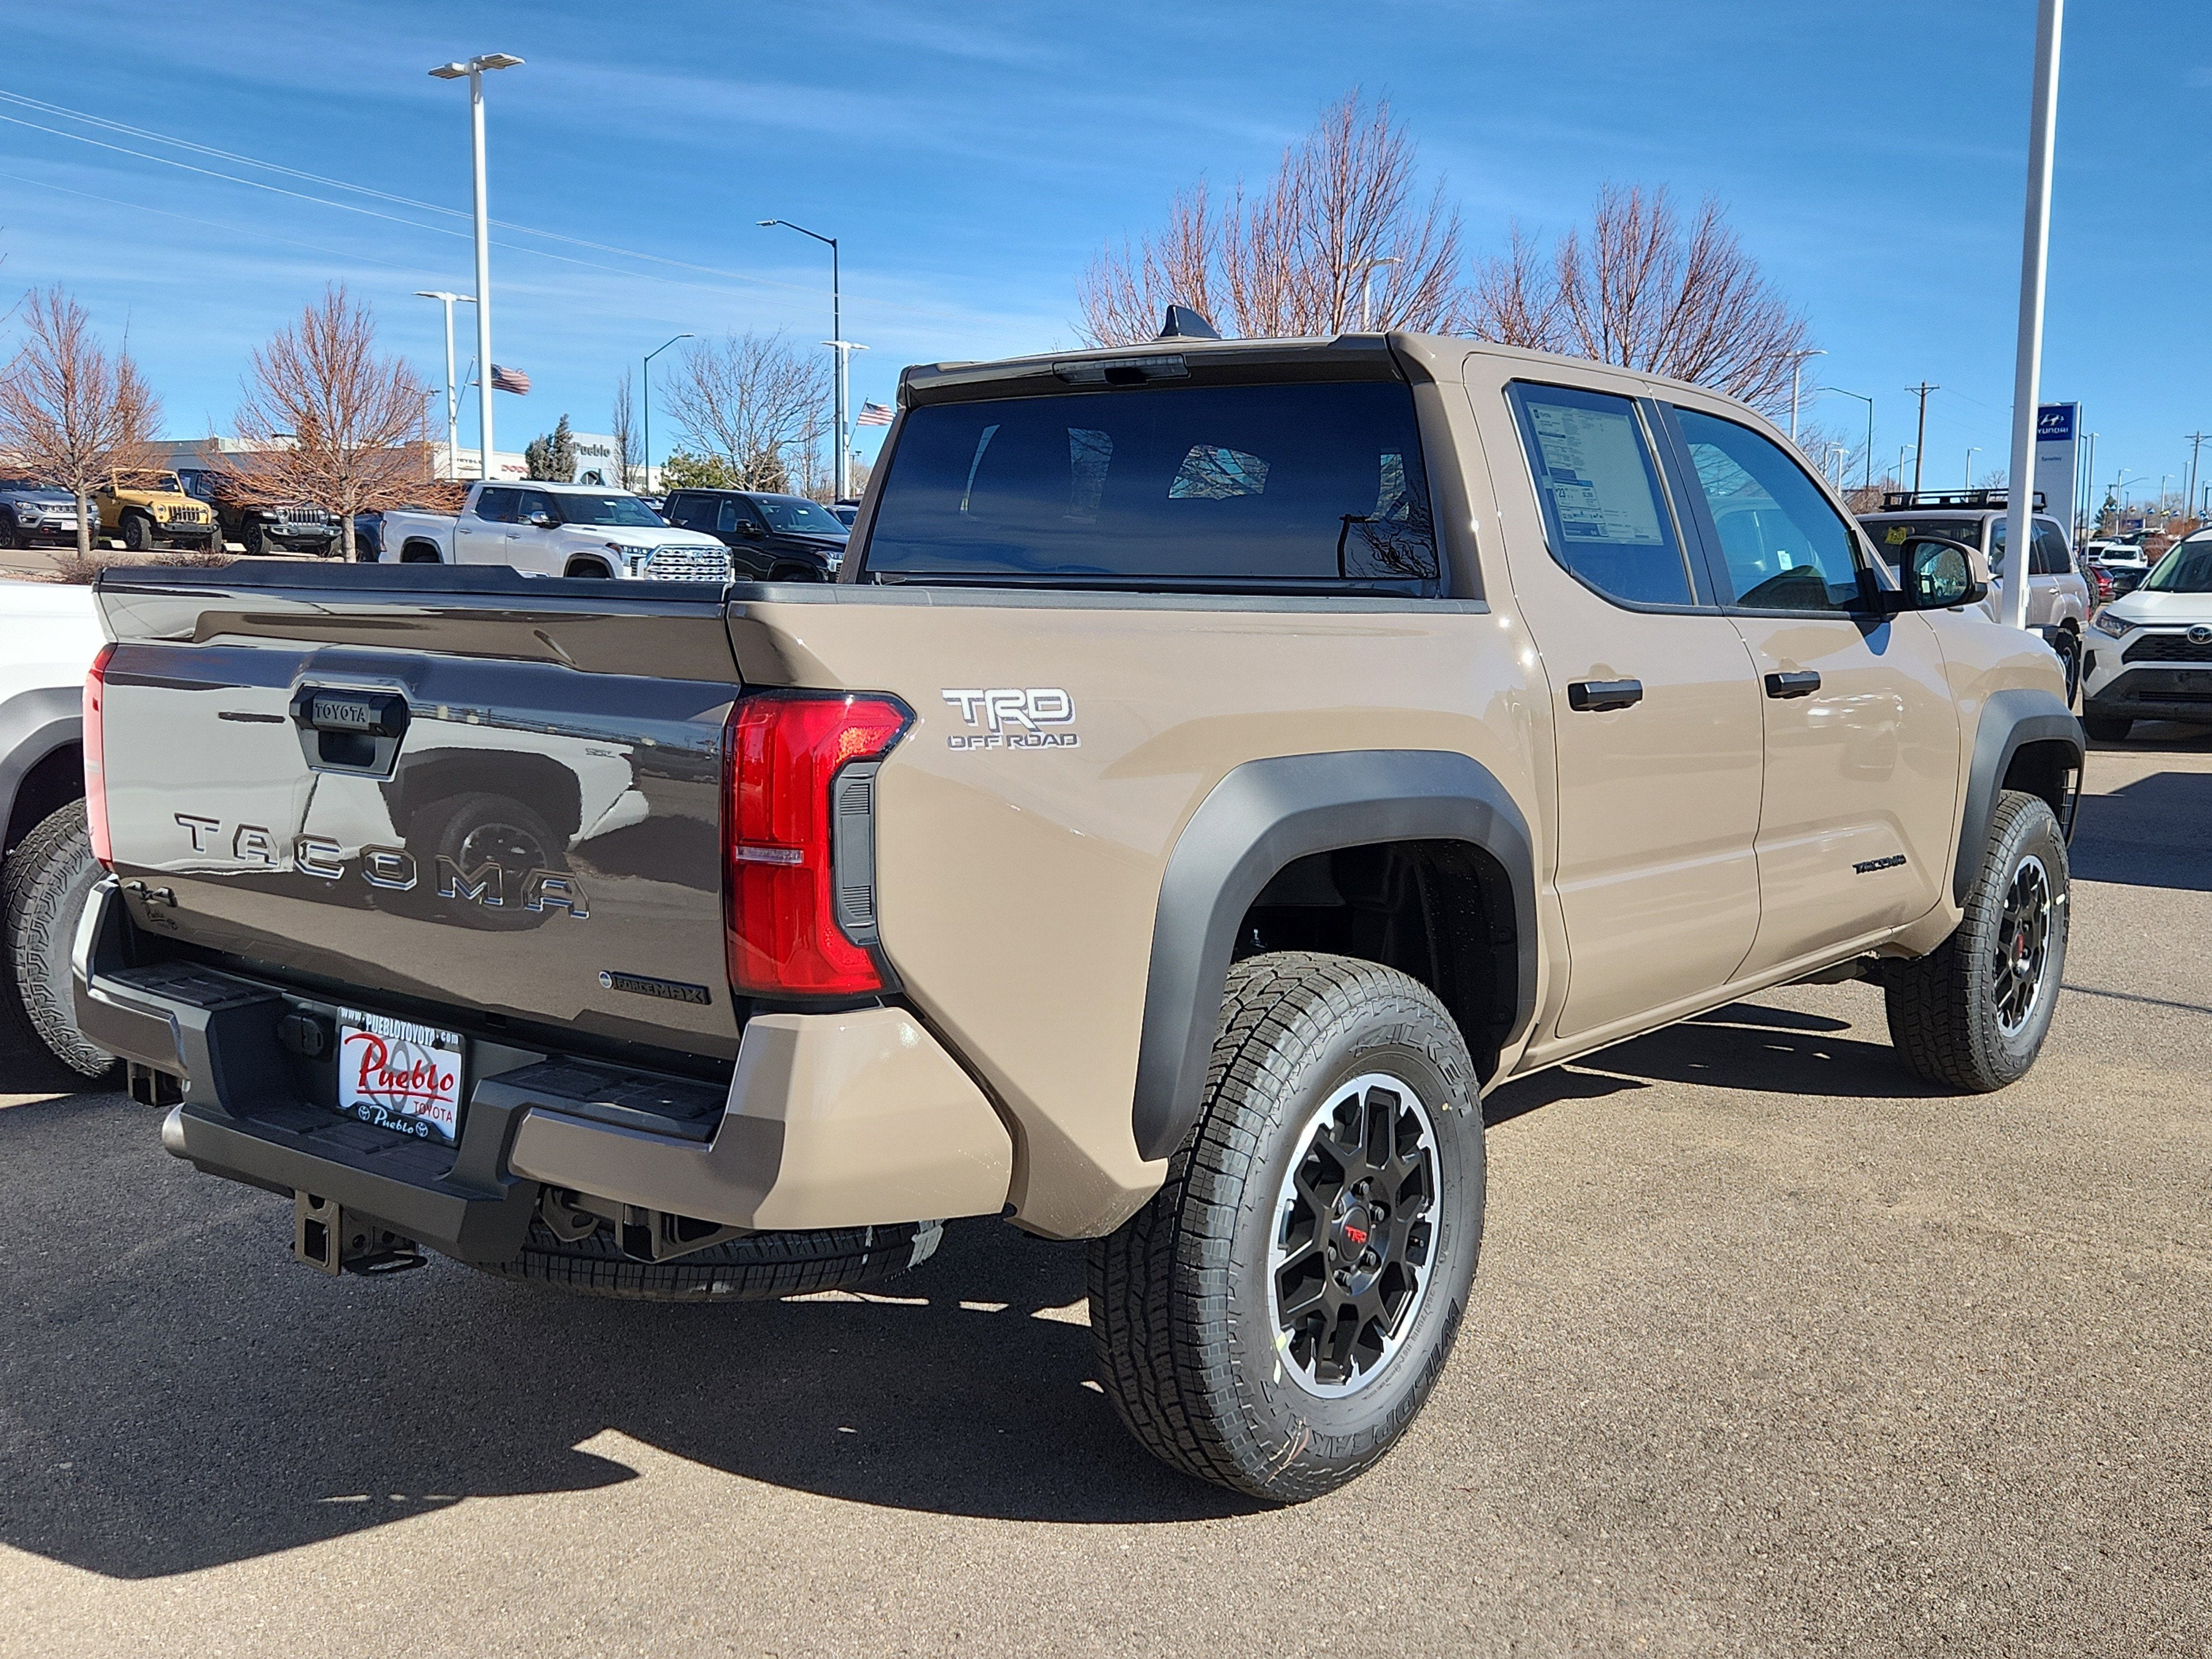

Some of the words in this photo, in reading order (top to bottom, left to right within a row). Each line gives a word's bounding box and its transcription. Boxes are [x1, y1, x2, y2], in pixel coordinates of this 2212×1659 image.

[573, 442, 611, 458] Pueblo
[315, 703, 366, 722] TOYOTA
[941, 688, 1076, 734] TRD
[948, 735, 1002, 750] OFF
[1006, 734, 1081, 750] ROAD
[175, 812, 590, 919] TACOMA
[344, 1033, 454, 1091] Pueblo
[370, 1105, 414, 1134] Pueblo
[414, 1101, 453, 1123] TOYOTA
[1345, 1225, 1367, 1244] TRD
